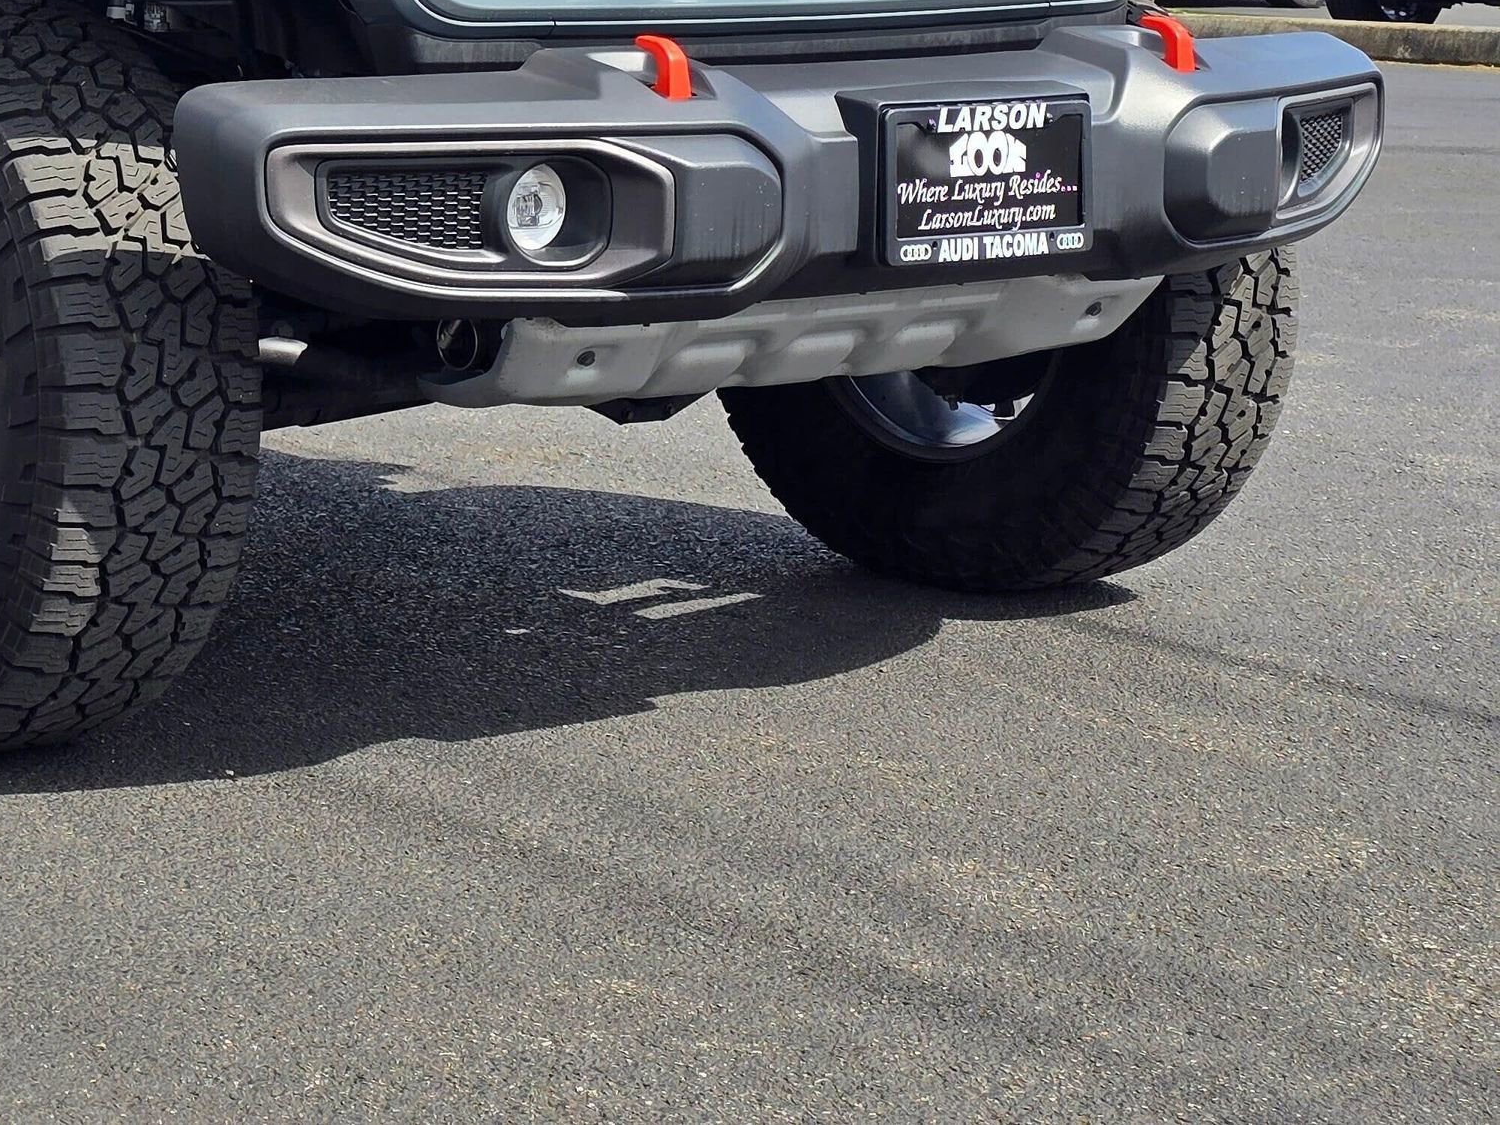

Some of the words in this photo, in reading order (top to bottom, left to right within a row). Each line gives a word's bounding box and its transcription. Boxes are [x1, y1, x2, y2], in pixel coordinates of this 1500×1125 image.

[937, 103, 1047, 133] LARSON
[897, 178, 949, 205] Where
[951, 179, 1005, 206] Luxury
[1008, 170, 1078, 199] Resides...
[918, 204, 1056, 232] LarsonLuxury.com
[938, 237, 979, 263] AUDI
[983, 232, 1049, 259] TACOMA
